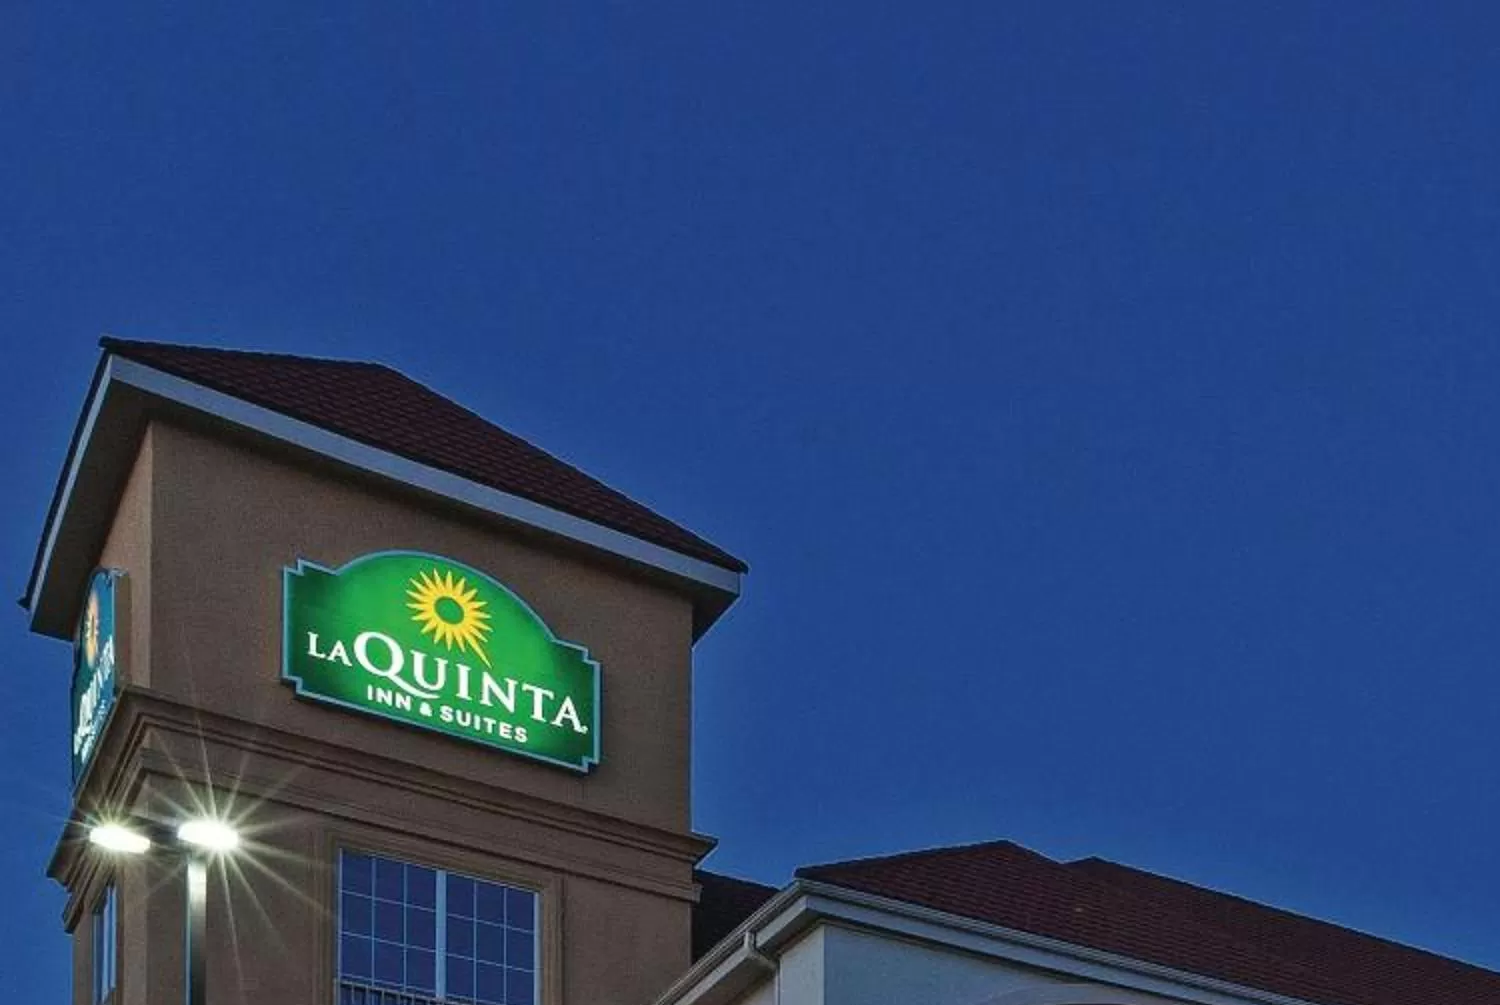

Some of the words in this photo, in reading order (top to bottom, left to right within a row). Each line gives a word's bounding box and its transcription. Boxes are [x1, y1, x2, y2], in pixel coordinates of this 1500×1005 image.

[307, 632, 352, 667] LA
[353, 631, 587, 734] QUINTA
[367, 684, 412, 712] INN
[419, 701, 433, 717] &
[439, 705, 528, 743] SUITES
